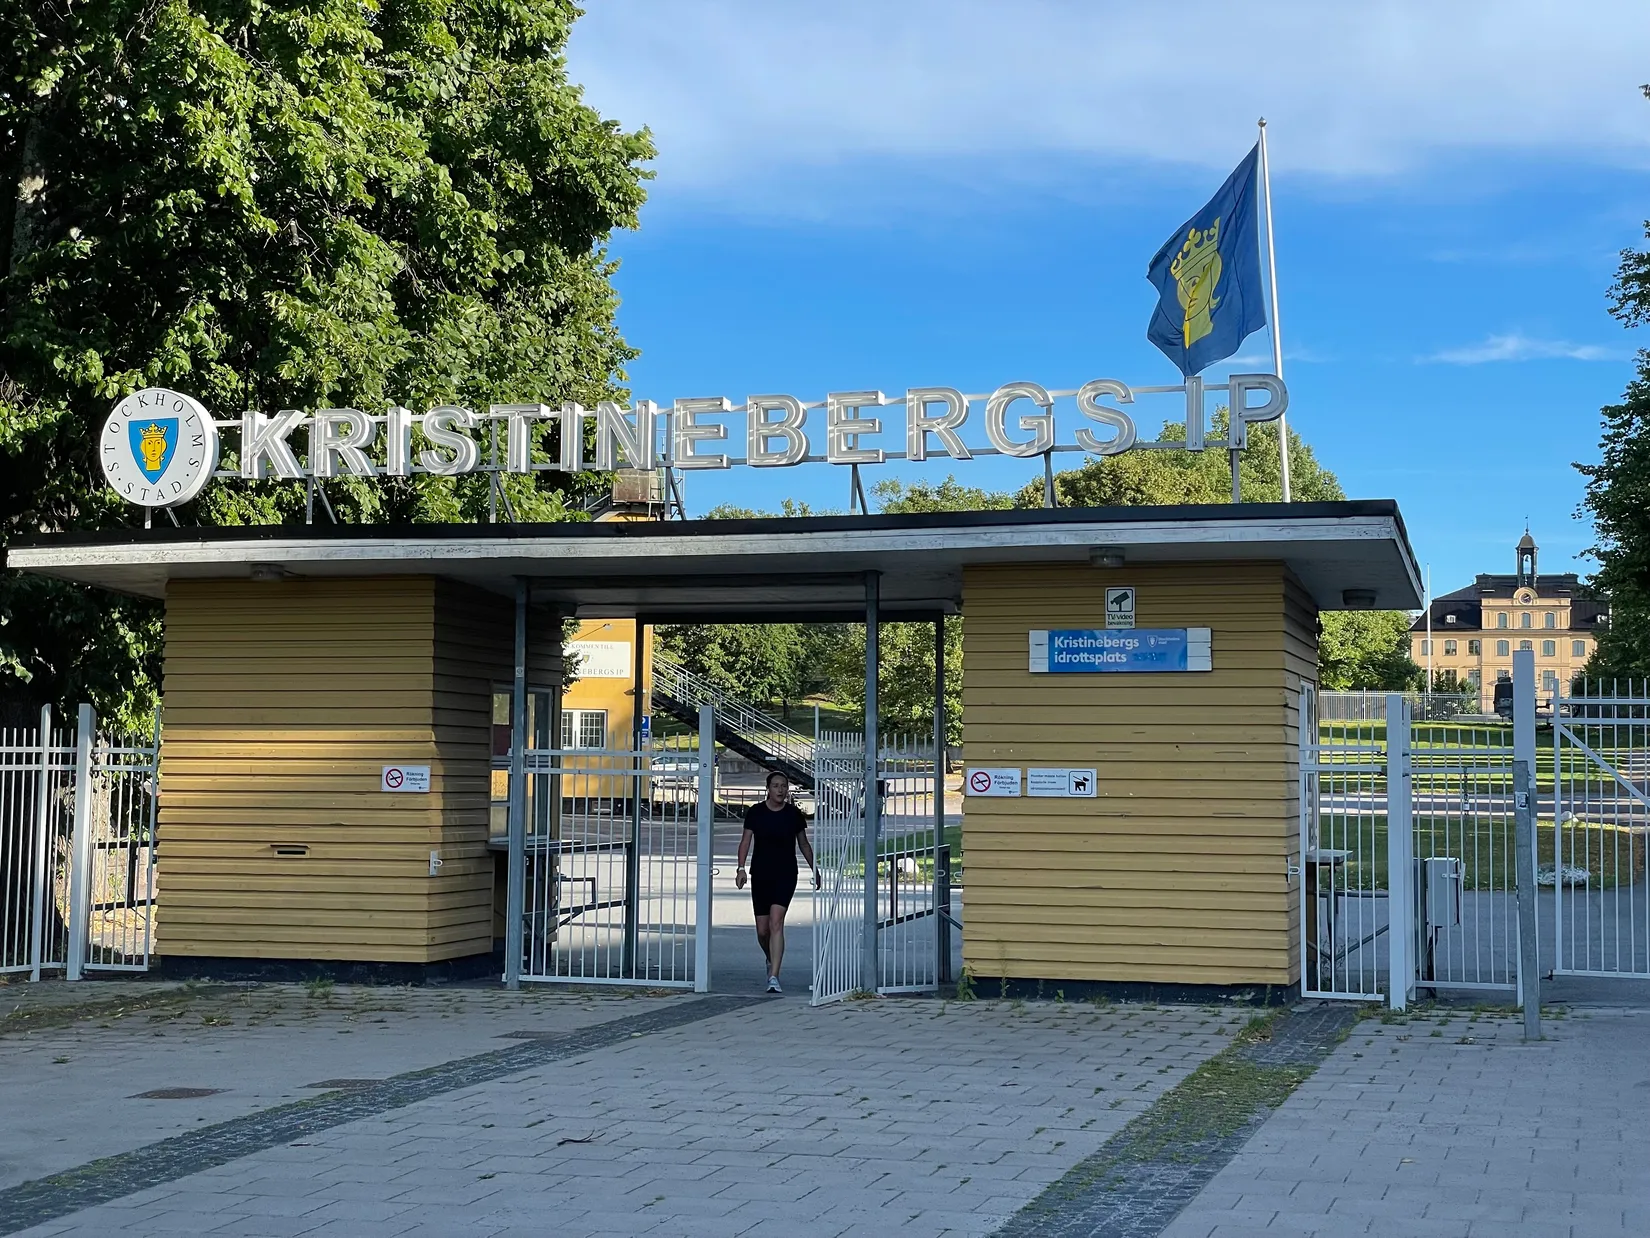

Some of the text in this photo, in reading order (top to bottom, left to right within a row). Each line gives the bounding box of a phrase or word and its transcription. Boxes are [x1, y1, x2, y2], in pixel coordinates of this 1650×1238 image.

[104, 393, 203, 472] STOCKHOLMS
[241, 373, 1289, 480] KRISTINEBERGS IP
[124, 481, 182, 500] STAD
[1054, 636, 1139, 650] Kristinebergs
[1054, 651, 1127, 665] idrottsplats
